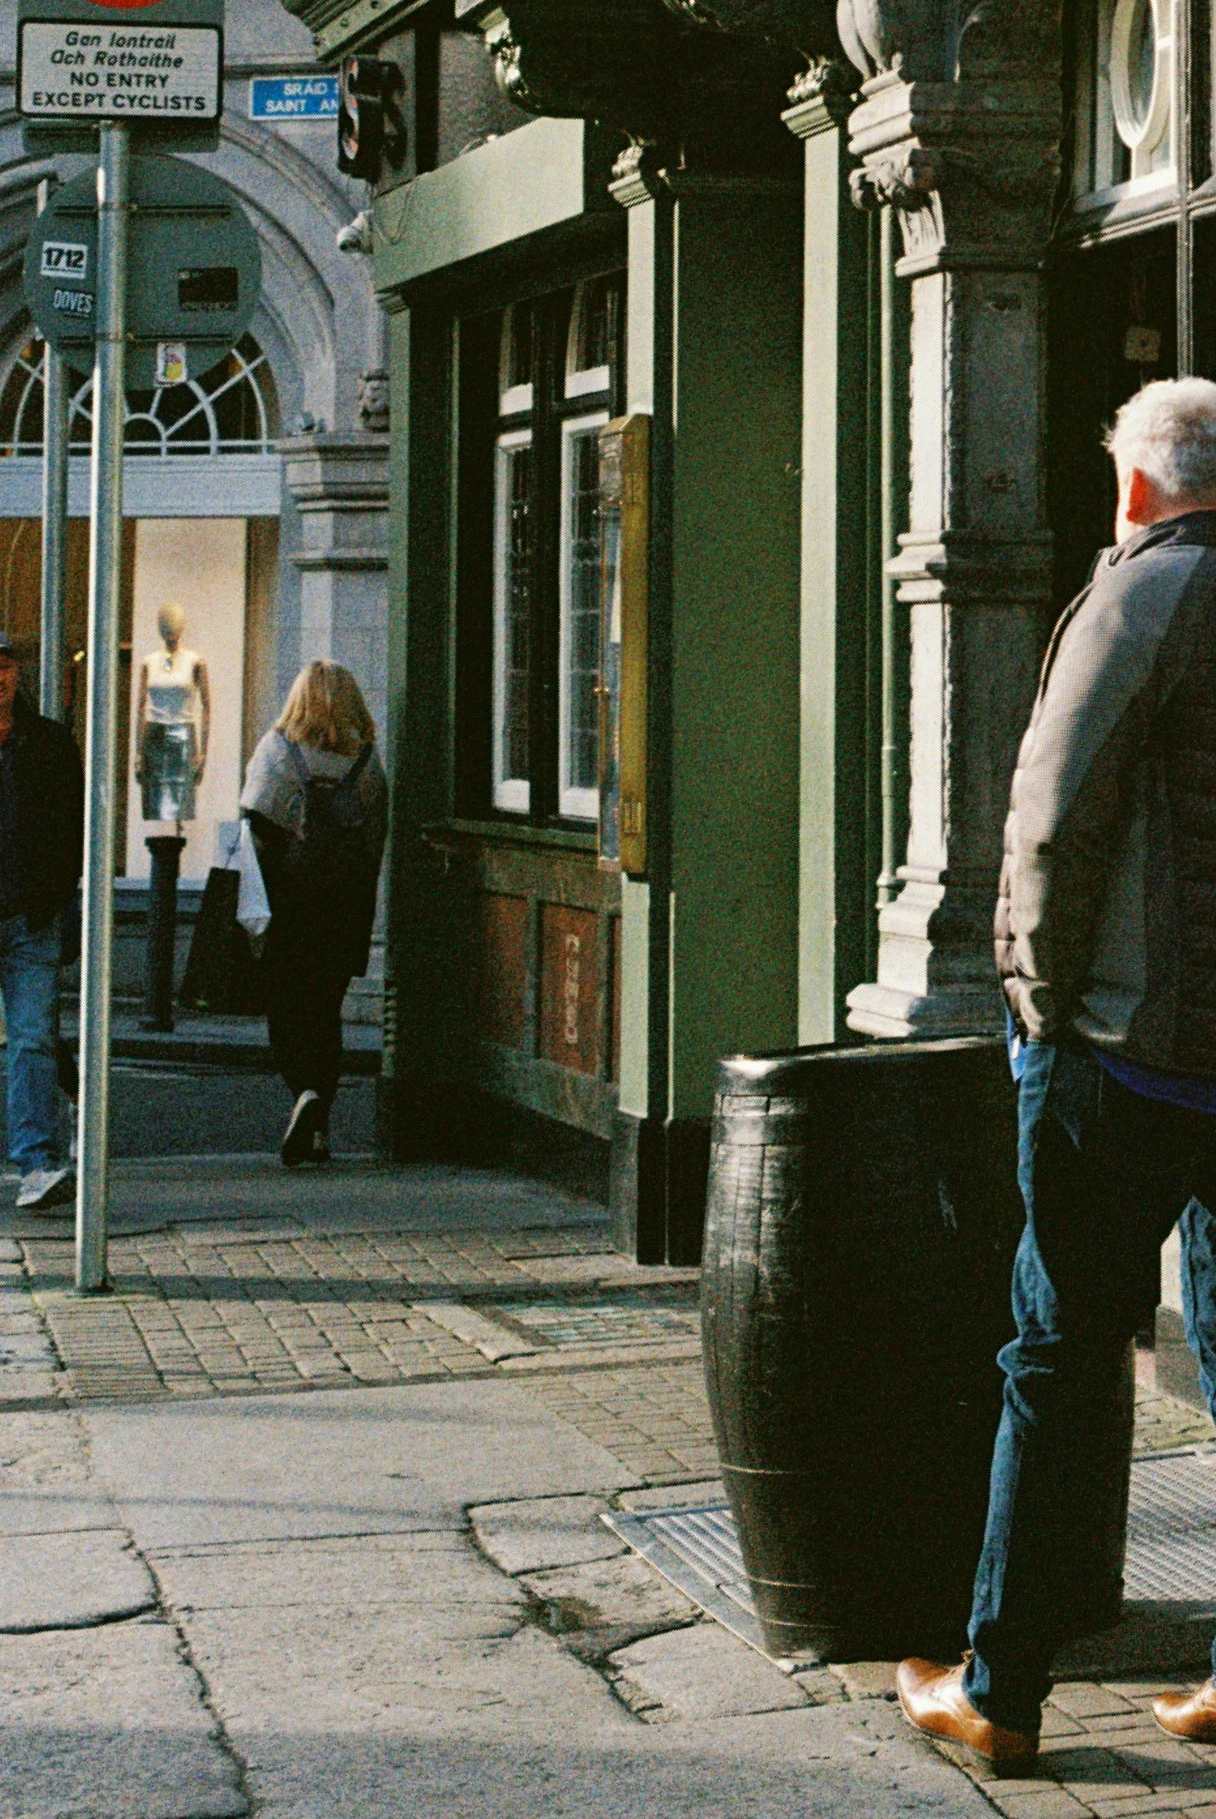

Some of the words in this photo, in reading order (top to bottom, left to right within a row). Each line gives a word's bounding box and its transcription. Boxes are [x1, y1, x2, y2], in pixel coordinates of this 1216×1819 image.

[65, 31, 101, 46] Gan
[50, 49, 85, 65] Ach
[94, 51, 184, 68] Rothaithe
[70, 72, 99, 86] NO
[107, 73, 170, 88] ENTRY
[32, 91, 106, 108] EXCEPT
[112, 93, 206, 111] CYCLISTS
[44, 247, 85, 268] 1712
